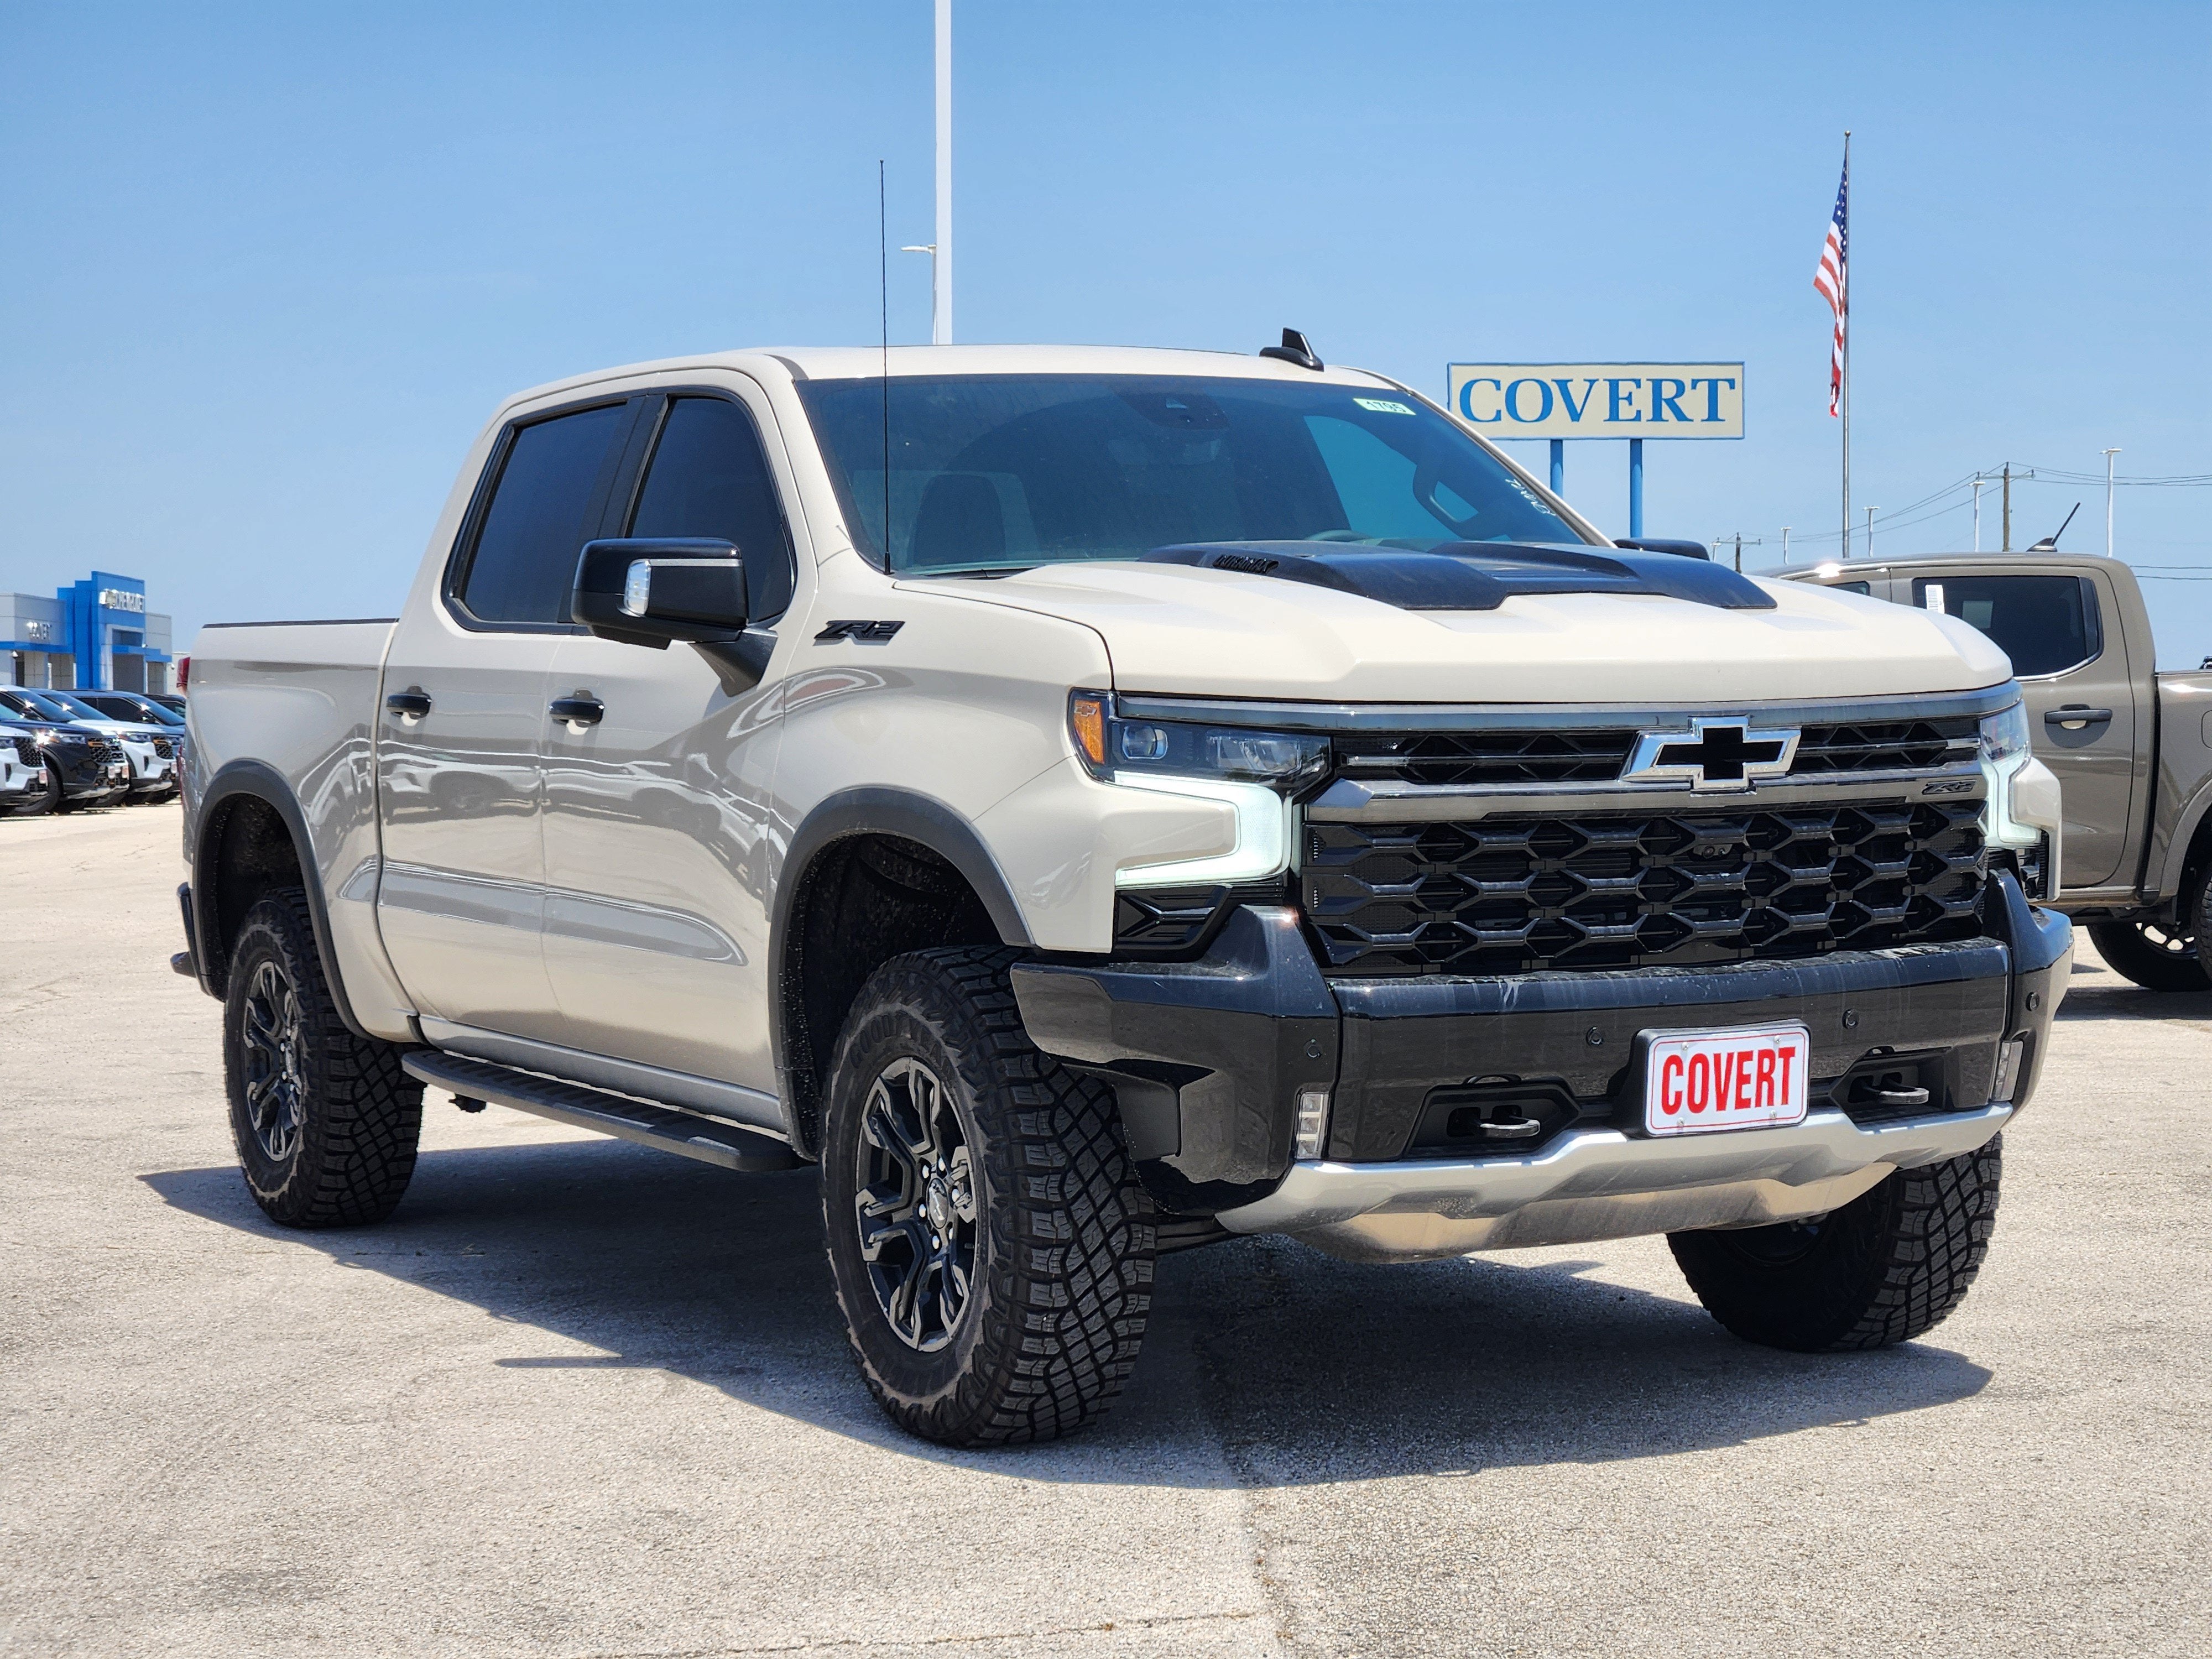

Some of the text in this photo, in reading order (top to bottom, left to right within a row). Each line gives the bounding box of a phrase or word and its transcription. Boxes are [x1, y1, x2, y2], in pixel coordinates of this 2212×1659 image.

[1459, 378, 1735, 422] COVERT
[814, 620, 906, 641] ZR2
[1922, 779, 1978, 795] ZR2
[1661, 1046, 1796, 1115] COVERT
